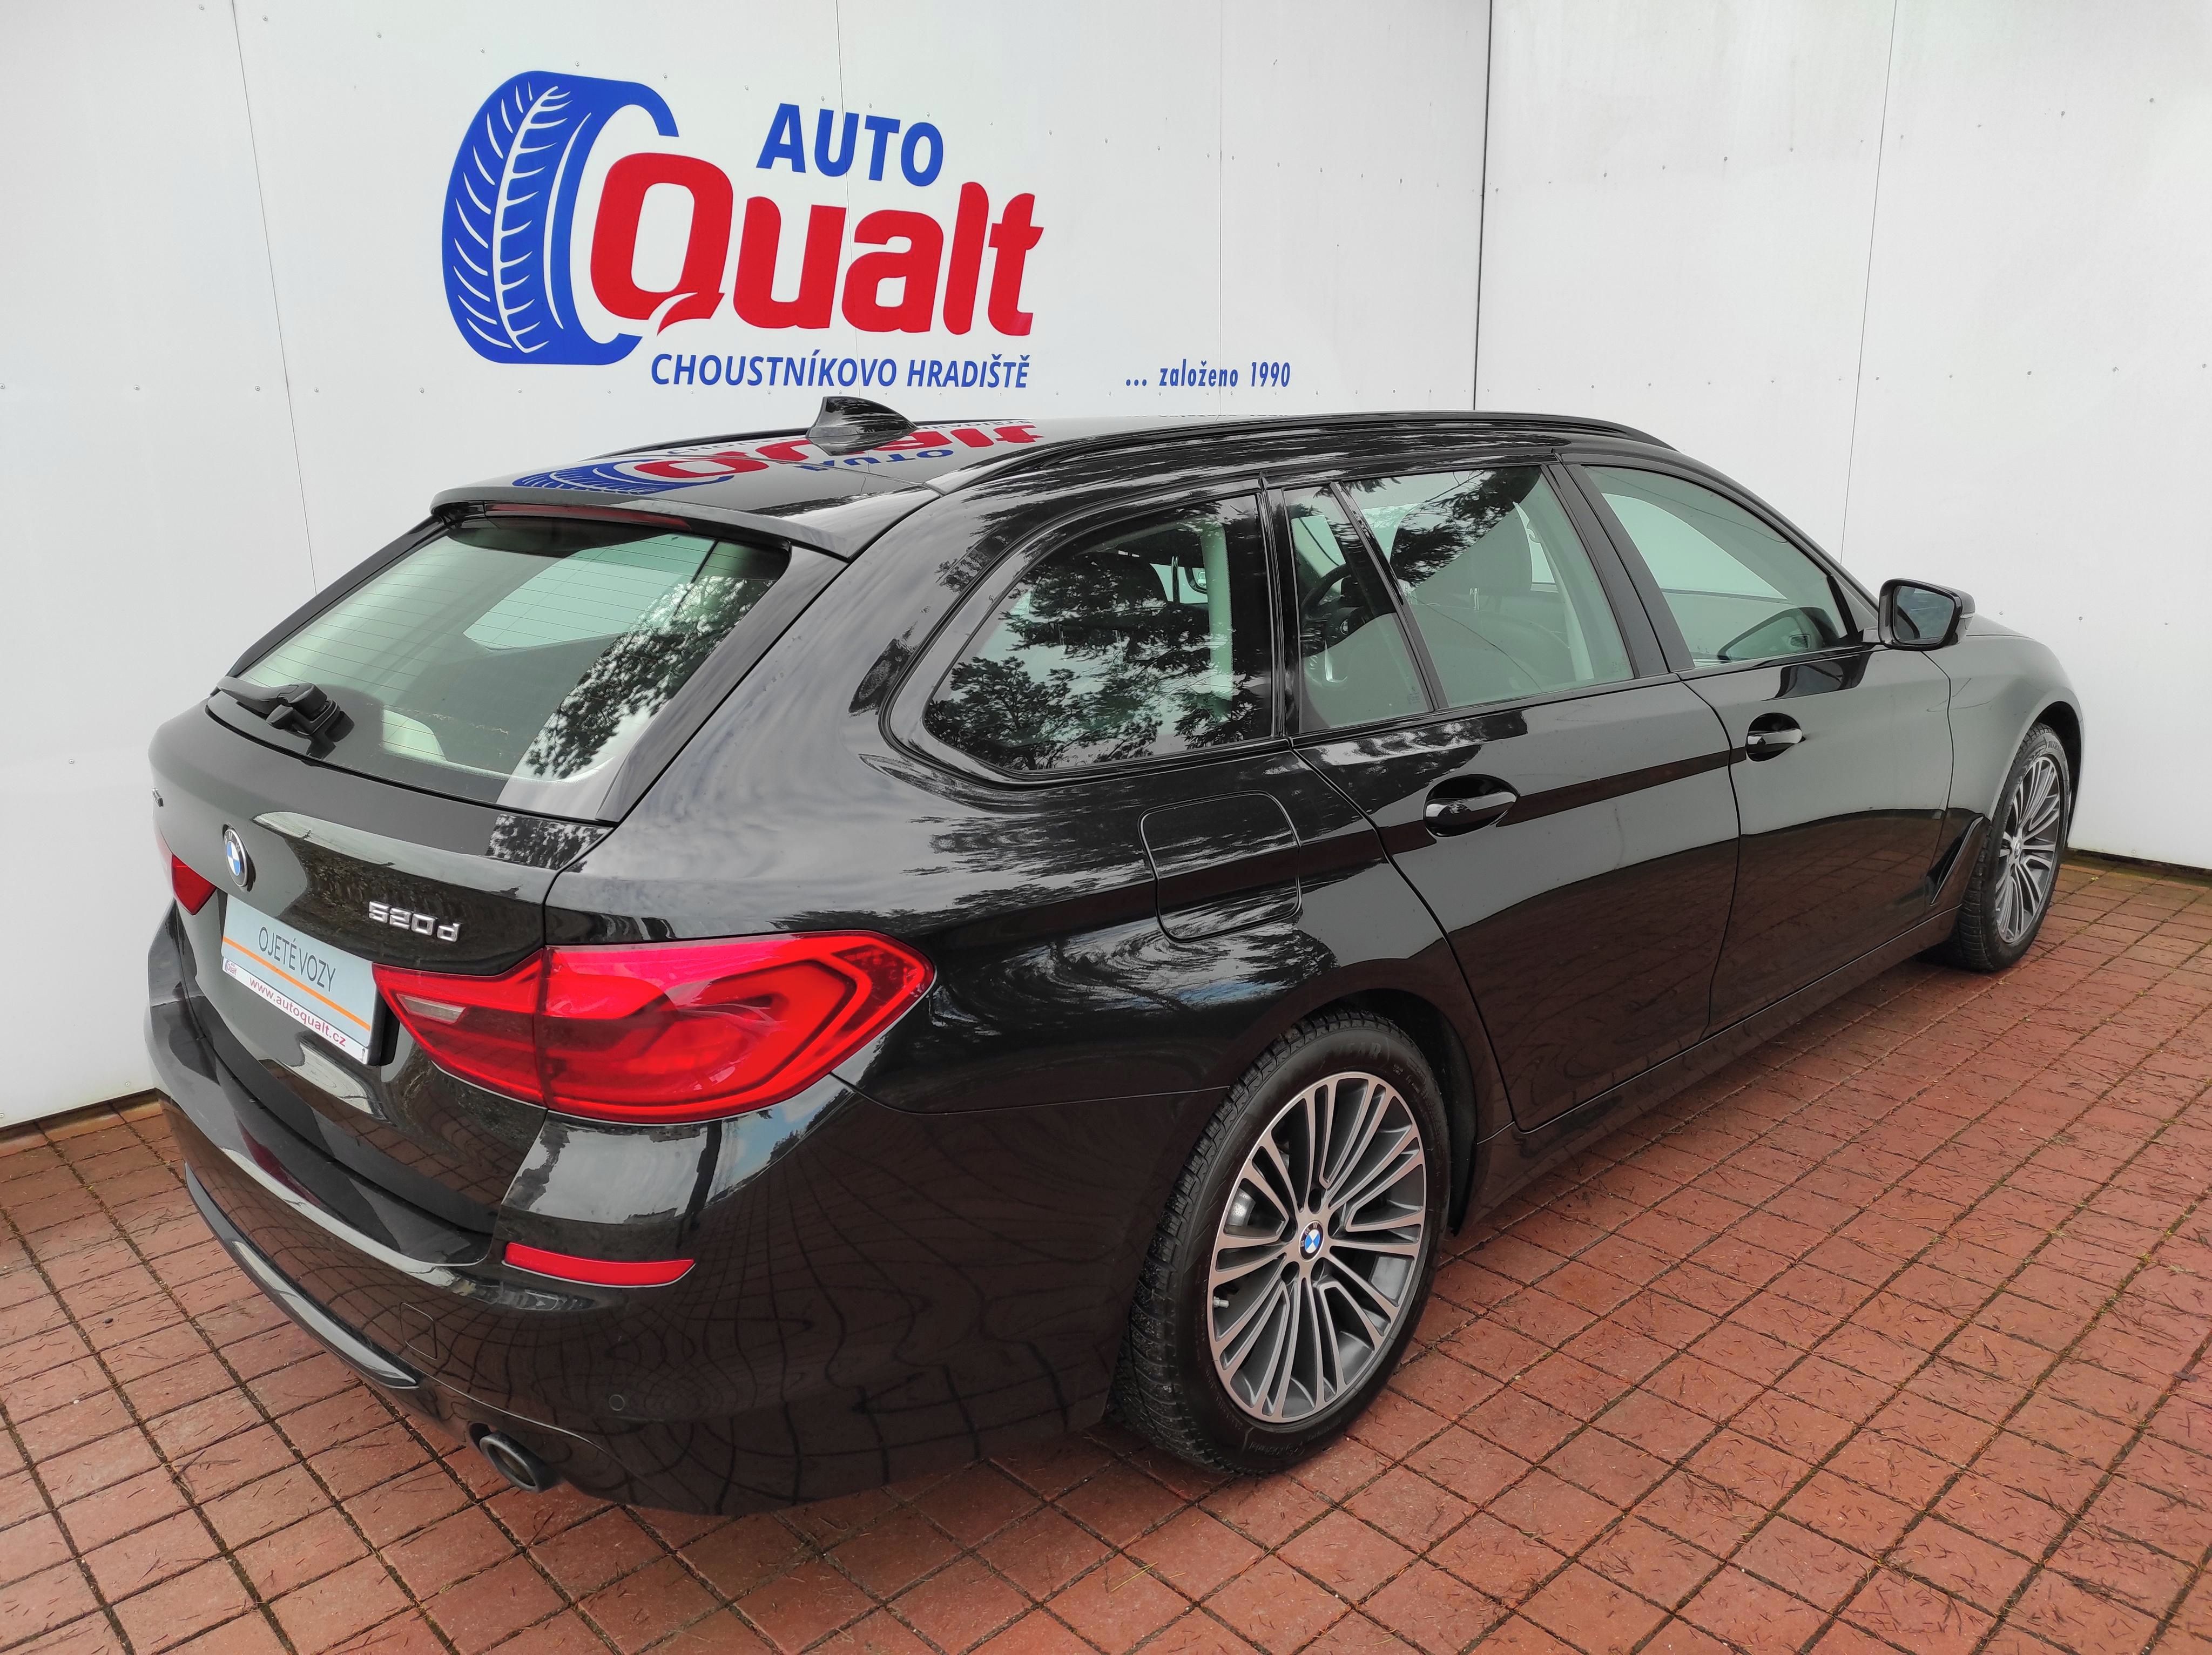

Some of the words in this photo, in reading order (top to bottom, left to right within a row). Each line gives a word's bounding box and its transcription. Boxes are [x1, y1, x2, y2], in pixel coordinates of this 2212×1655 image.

[756, 103, 945, 187] AUTO
[590, 152, 1044, 337] Qualt
[650, 349, 898, 388] CHOUSTNÍKOVO
[907, 354, 1030, 389] HRADIŠTĚ
[1159, 359, 1239, 388] založeno
[1251, 362, 1291, 388] 1990
[368, 900, 462, 942] 520d
[259, 926, 298, 971] OJETÉ
[298, 946, 336, 992] VOZY
[249, 977, 346, 1047] www.autoqualt.cz
[1300, 1221, 1318, 1247] BMW
